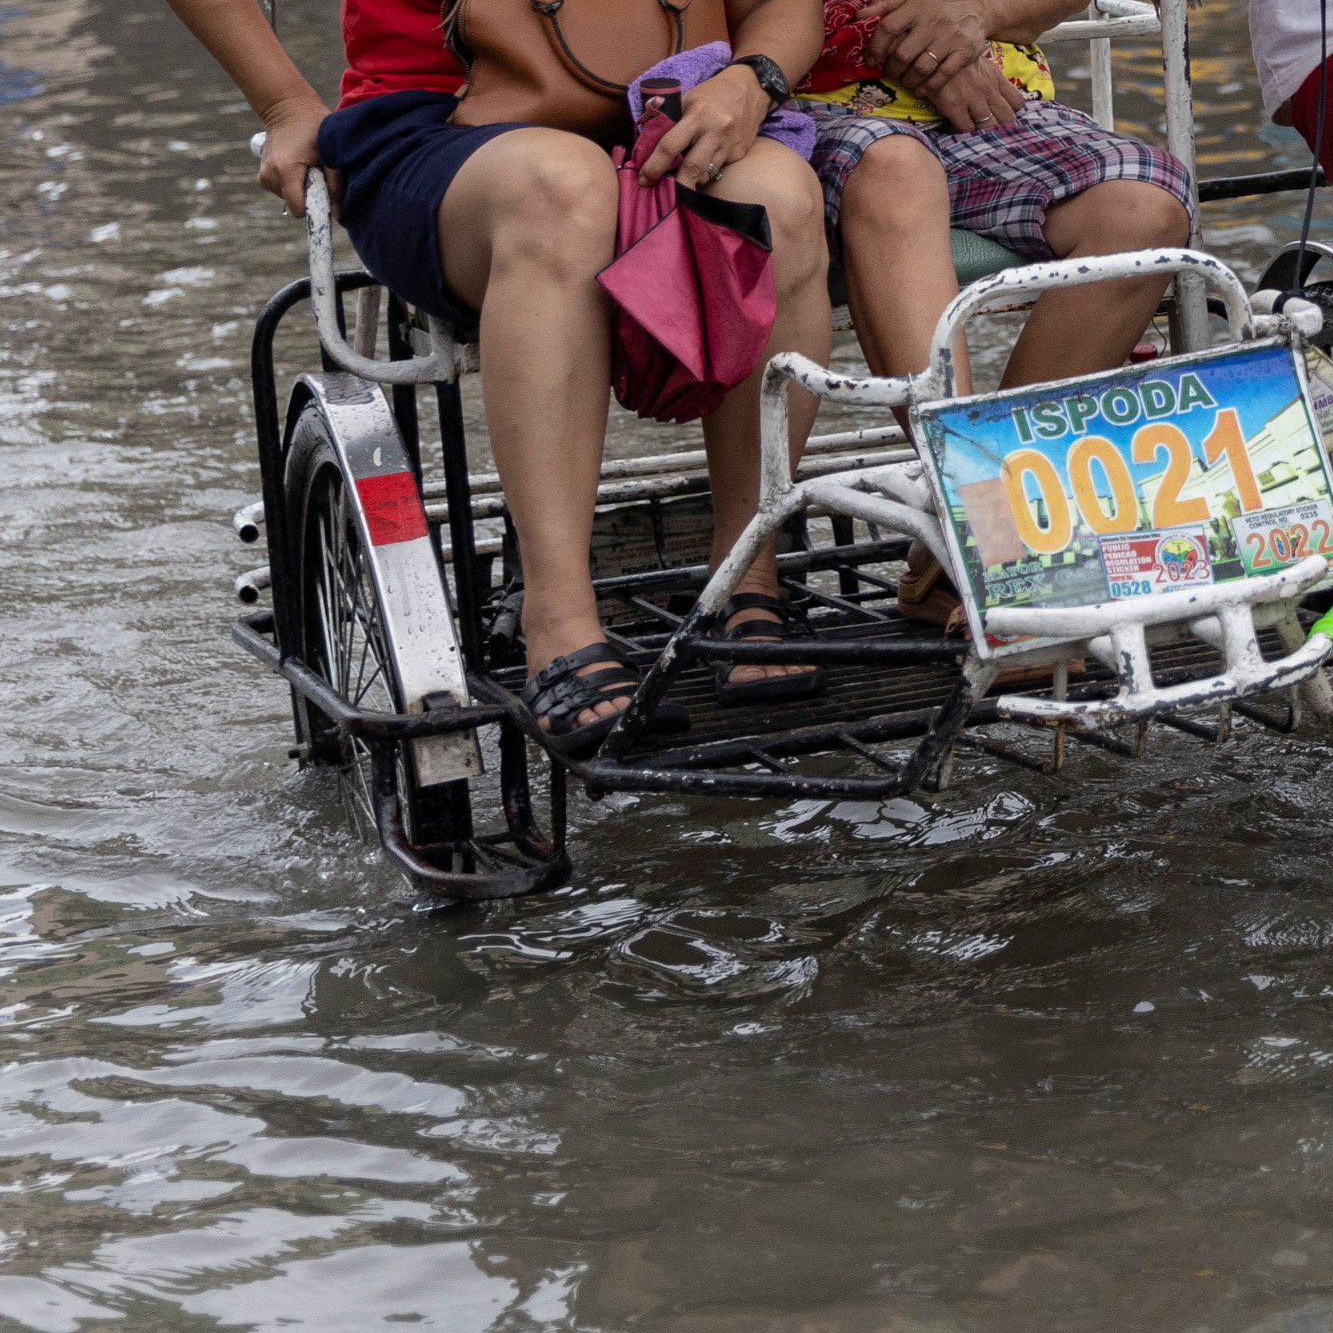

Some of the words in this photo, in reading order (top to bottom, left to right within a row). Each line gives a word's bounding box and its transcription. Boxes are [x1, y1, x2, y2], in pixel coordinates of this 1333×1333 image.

[1012, 372, 1217, 443] ISPODA
[1000, 407, 1264, 555] 0021
[1245, 516, 1261, 524] VCTO
[1261, 508, 1295, 521] REGULATORY
[1296, 504, 1319, 514] STICKER
[1249, 520, 1278, 530] CONTROL
[1300, 511, 1319, 521] 0235
[1102, 543, 1130, 552] PUBLIC
[1103, 550, 1137, 560] PEDICAB
[684, 555, 711, 564] MATR
[1105, 556, 1152, 567] REGULATION
[982, 561, 1043, 583] MAYOR
[1106, 565, 1140, 575] STICKER
[1151, 559, 1211, 584] 2023
[985, 573, 1047, 602] REX
[1111, 580, 1152, 598] 0528
